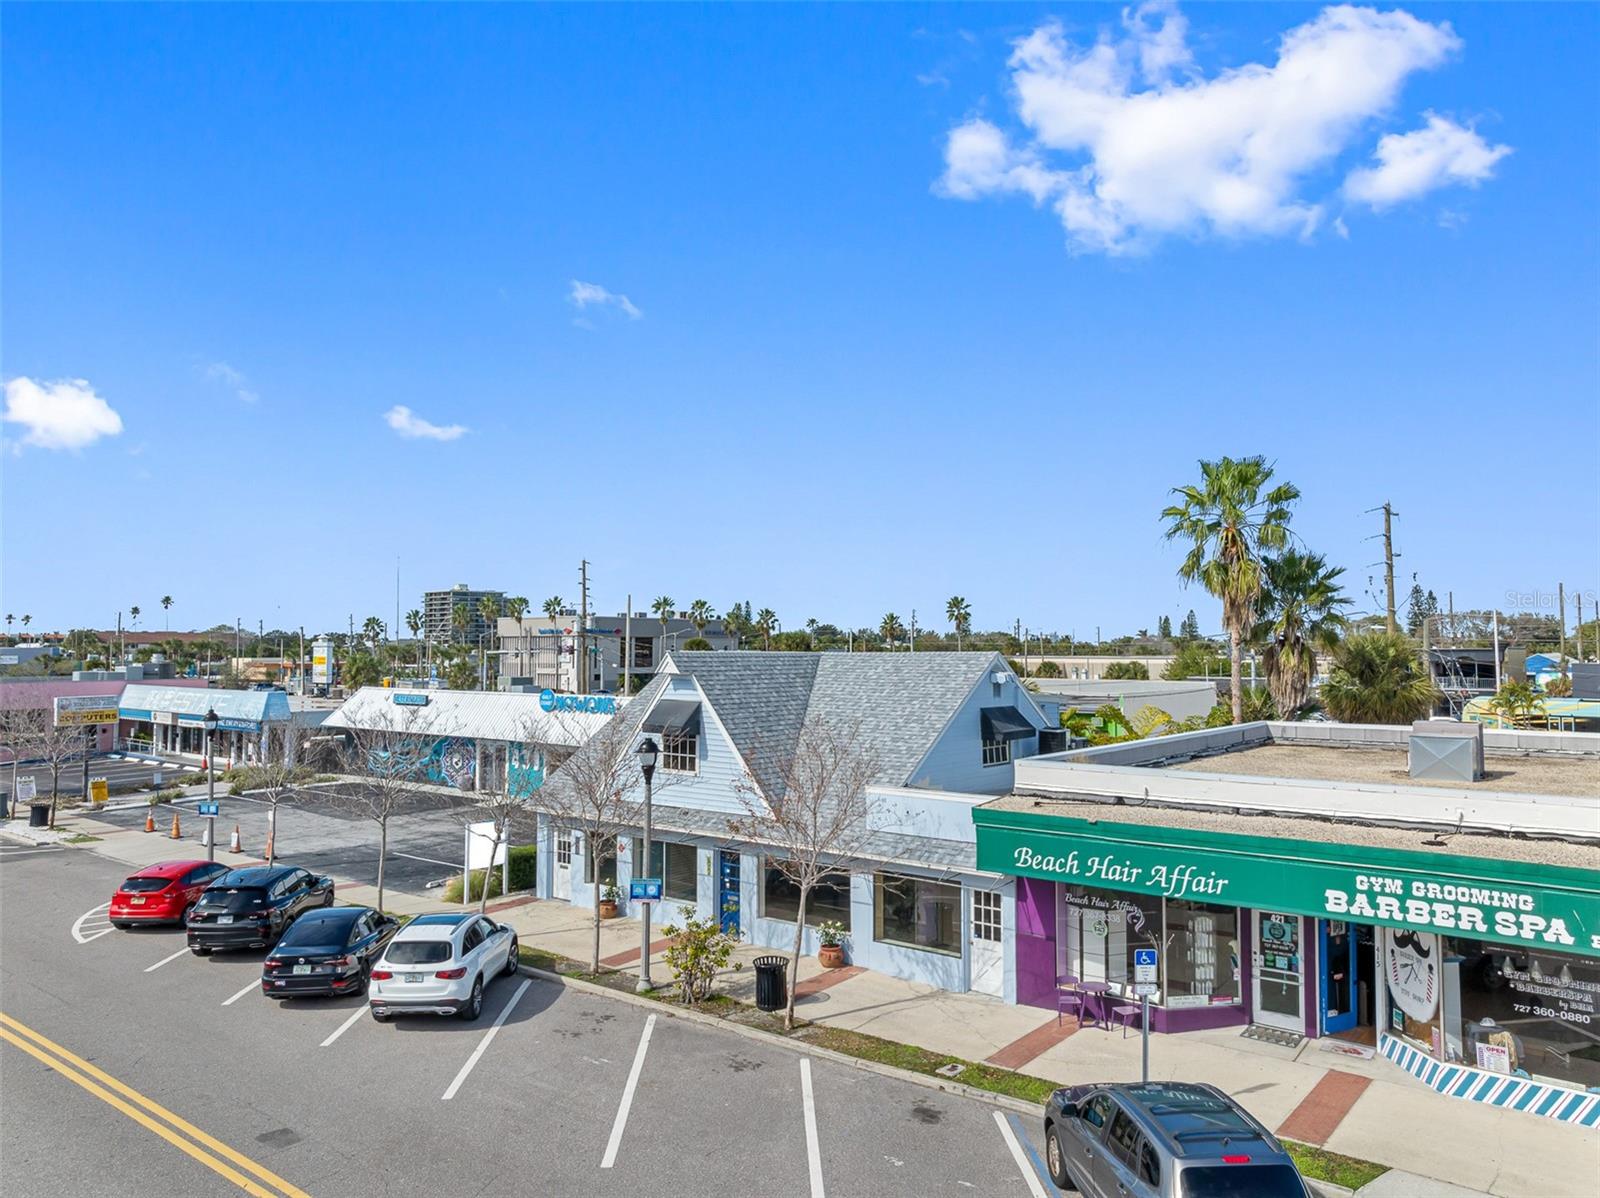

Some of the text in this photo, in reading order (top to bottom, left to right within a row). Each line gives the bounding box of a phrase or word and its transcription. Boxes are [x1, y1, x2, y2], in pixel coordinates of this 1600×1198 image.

[59, 712, 118, 724] COPUTERS
[1014, 847, 1229, 897] Beach Hair Affair
[1356, 875, 1535, 911] GYM GROOMING
[1065, 893, 1138, 913] Beach Hair Affair
[1271, 914, 1285, 923] 421
[1324, 889, 1575, 945] BARBER SPA
[1504, 969, 1531, 981] GYM
[1559, 1000, 1569, 1010] by
[1513, 1004, 1591, 1024] 727 360-0880
[1486, 1046, 1506, 1055] OPEN
